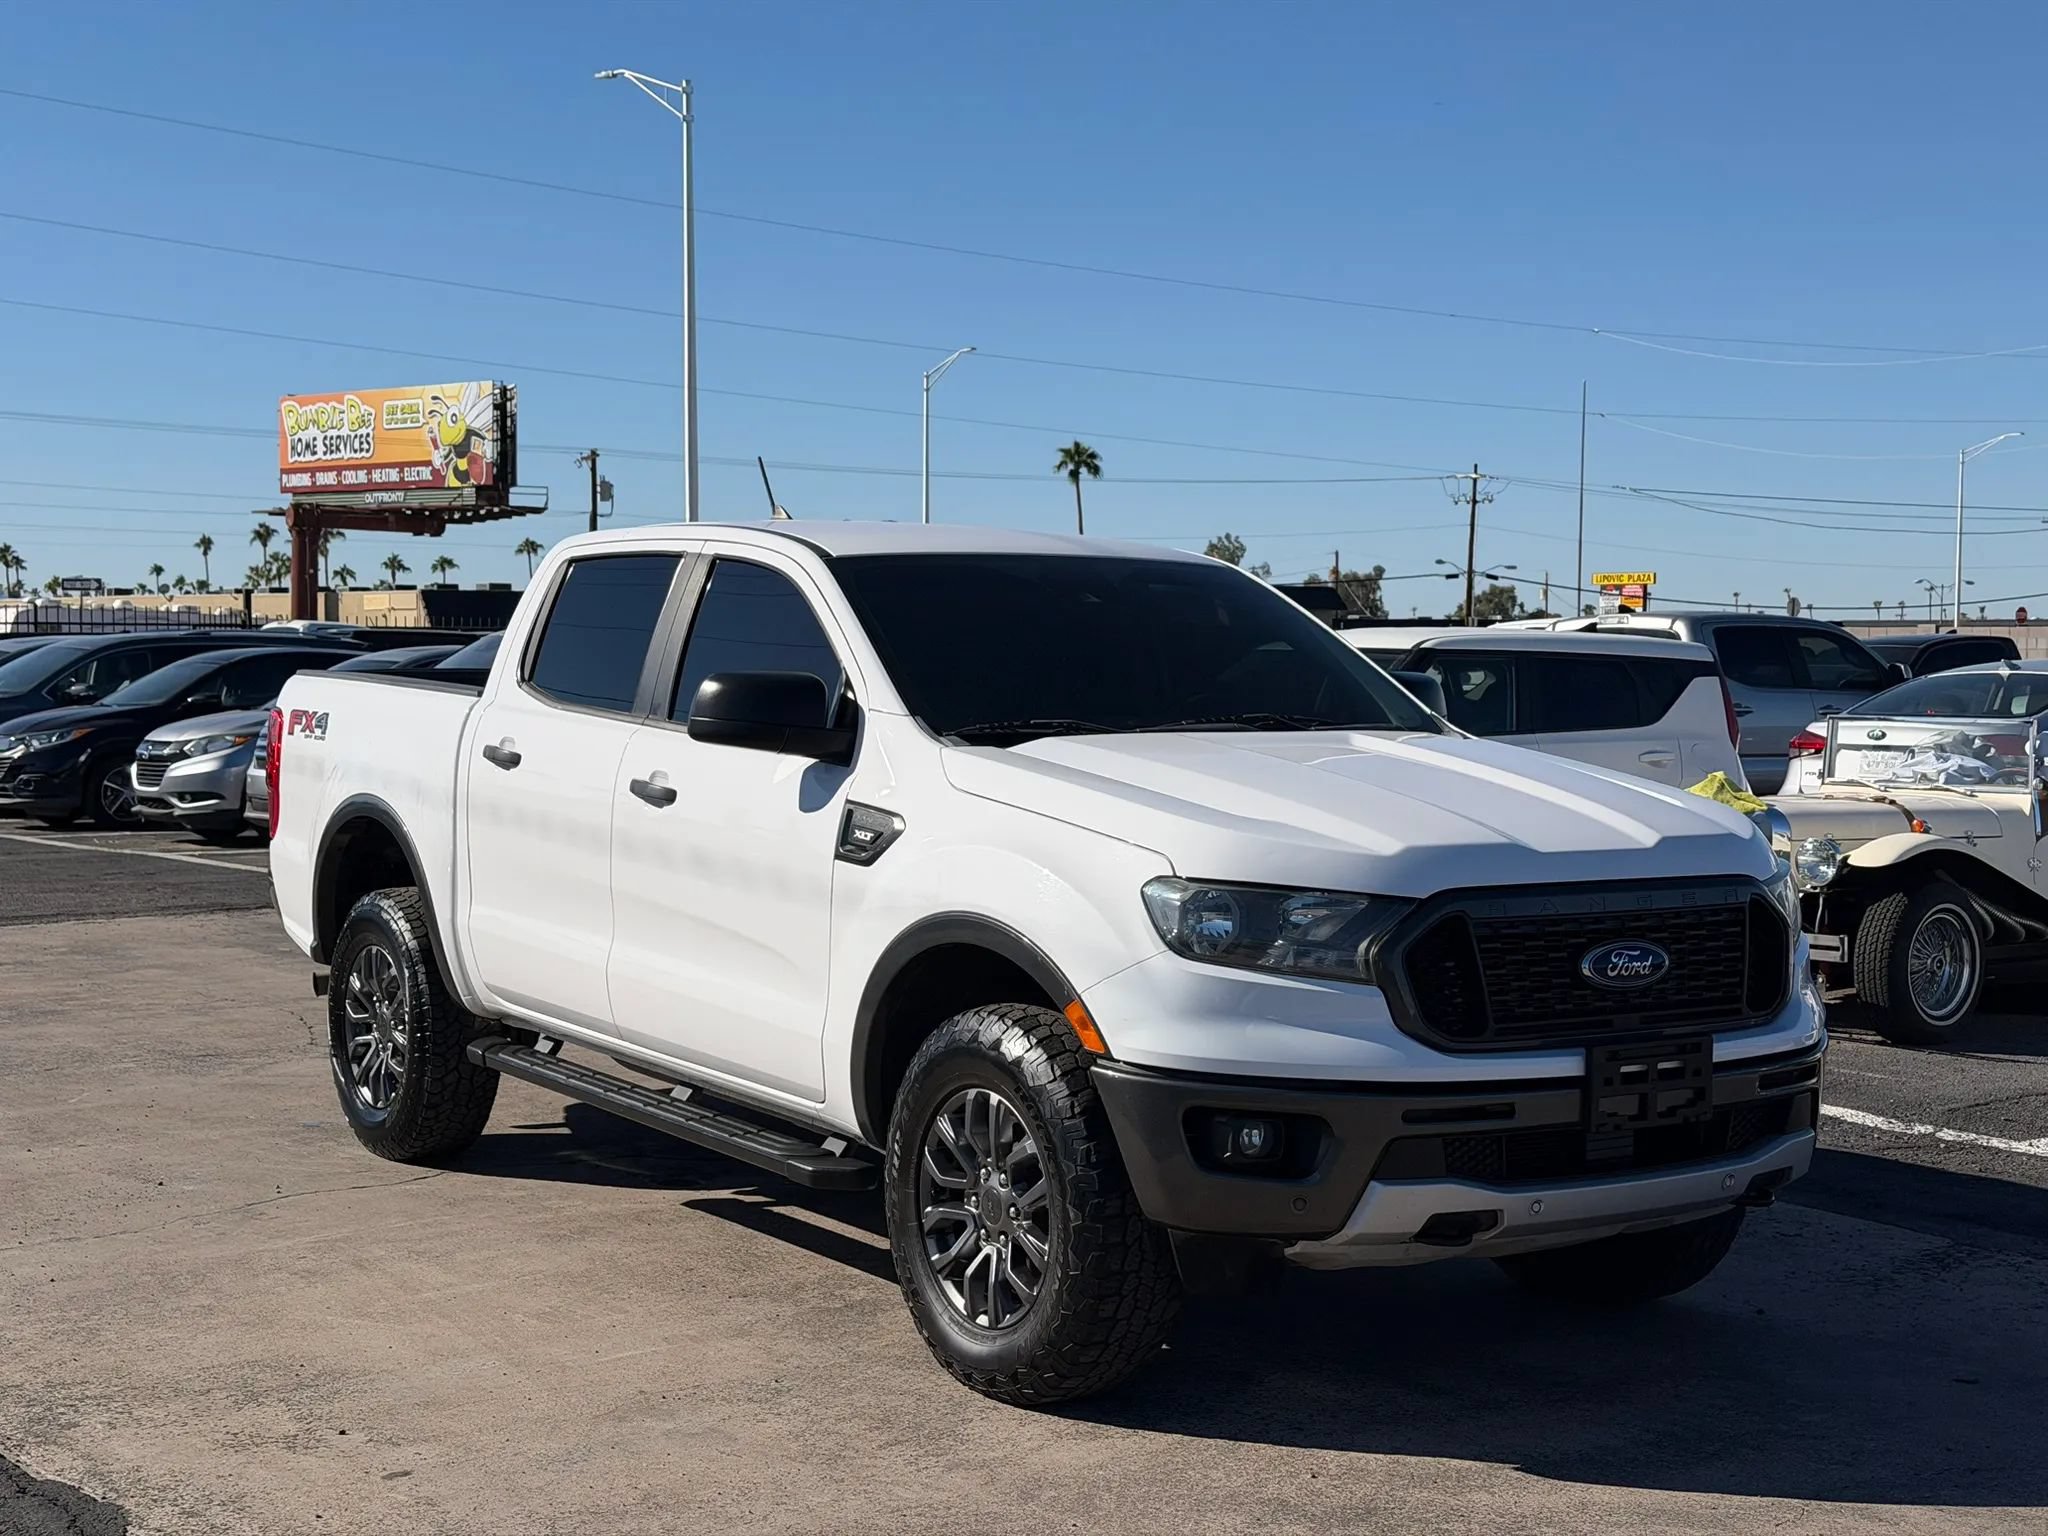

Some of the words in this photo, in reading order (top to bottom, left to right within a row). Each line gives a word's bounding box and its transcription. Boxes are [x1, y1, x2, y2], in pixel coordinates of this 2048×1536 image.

[290, 436, 318, 459] HOME
[322, 432, 371, 457] SERVICES
[282, 472, 312, 488] PLUMBING
[316, 470, 338, 486] DRAINS
[341, 469, 368, 485] COOLING
[372, 467, 400, 483] HEATING
[404, 465, 433, 481] ELECTRIC
[1595, 574, 1625, 583] LIPOVIC
[1627, 573, 1652, 583] PLAZA
[287, 709, 330, 736] FX4
[853, 829, 875, 841] XLT
[1606, 949, 1654, 977] Ford
